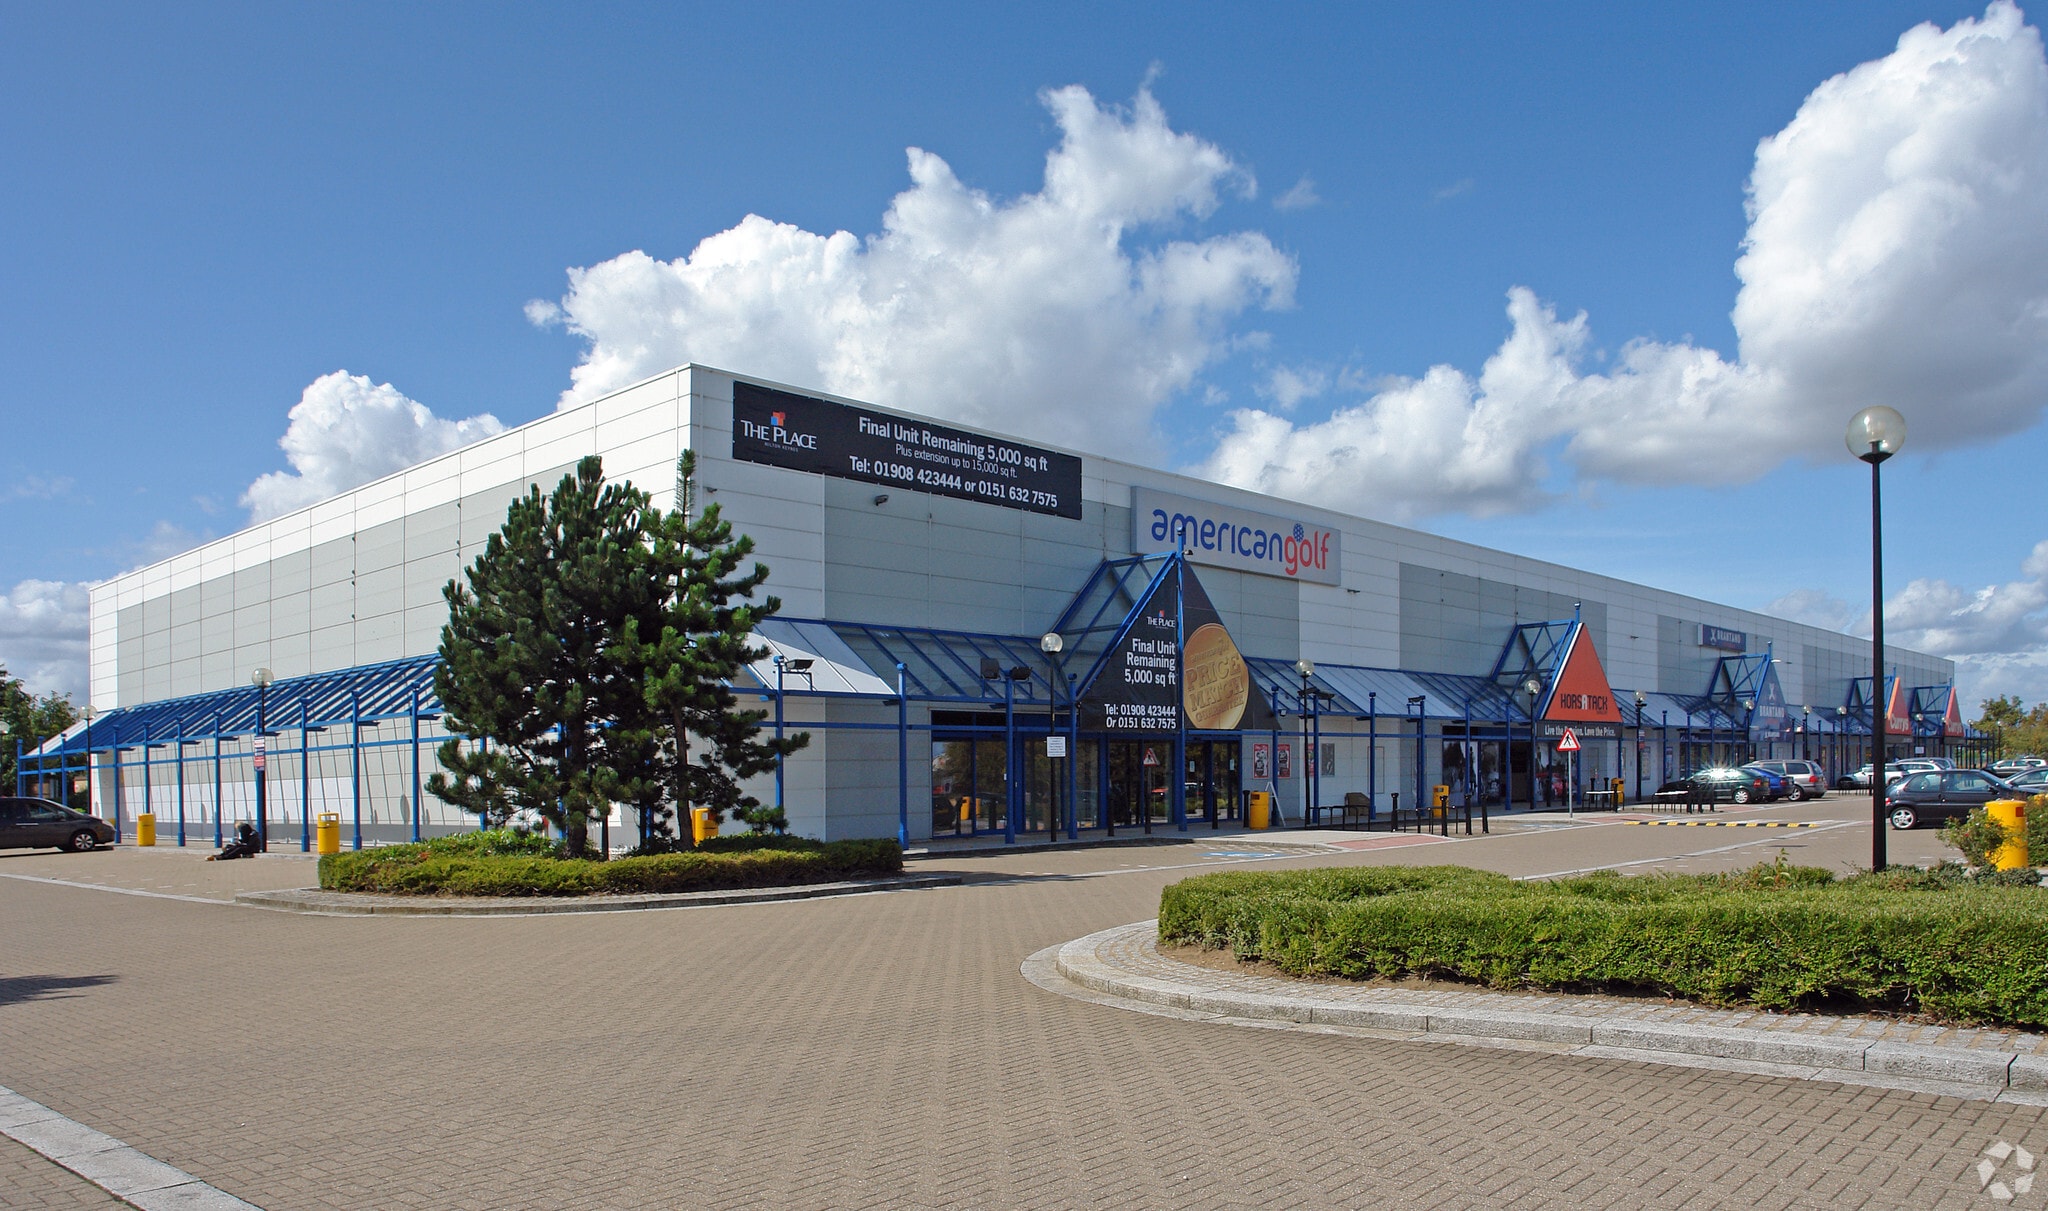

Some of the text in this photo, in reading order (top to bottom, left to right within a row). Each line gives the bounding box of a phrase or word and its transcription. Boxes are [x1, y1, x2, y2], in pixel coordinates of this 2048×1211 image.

[740, 420, 817, 450] THE PLACE
[859, 416, 1048, 472] Final Unit Remaining 5,000 sq ft
[895, 443, 912, 457] Plus
[914, 449, 949, 465] extension
[951, 458, 960, 468] up
[962, 458, 970, 468] to
[973, 459, 998, 475] 15,000
[1000, 466, 1009, 478] sq
[849, 455, 1058, 508] Tel: 01908 423444 or 0151 632 7575
[1147, 616, 1176, 628] THE PLACE
[1132, 638, 1154, 653] Final
[1157, 640, 1176, 655] Unit
[1127, 651, 1176, 671] Remaining
[1124, 668, 1176, 687] 5,000 sq ft
[1185, 655, 1241, 692] PRICE
[1189, 675, 1245, 712] MATCH
[1560, 694, 1608, 710] HORSATACK
[1104, 704, 1176, 717] Tel: 01908 423444
[1106, 717, 1177, 729] Or 0151 632 7575
[1544, 725, 1555, 736] Live
[1555, 725, 1564, 736] the
[1584, 726, 1595, 736] Love
[1595, 727, 1603, 736] the
